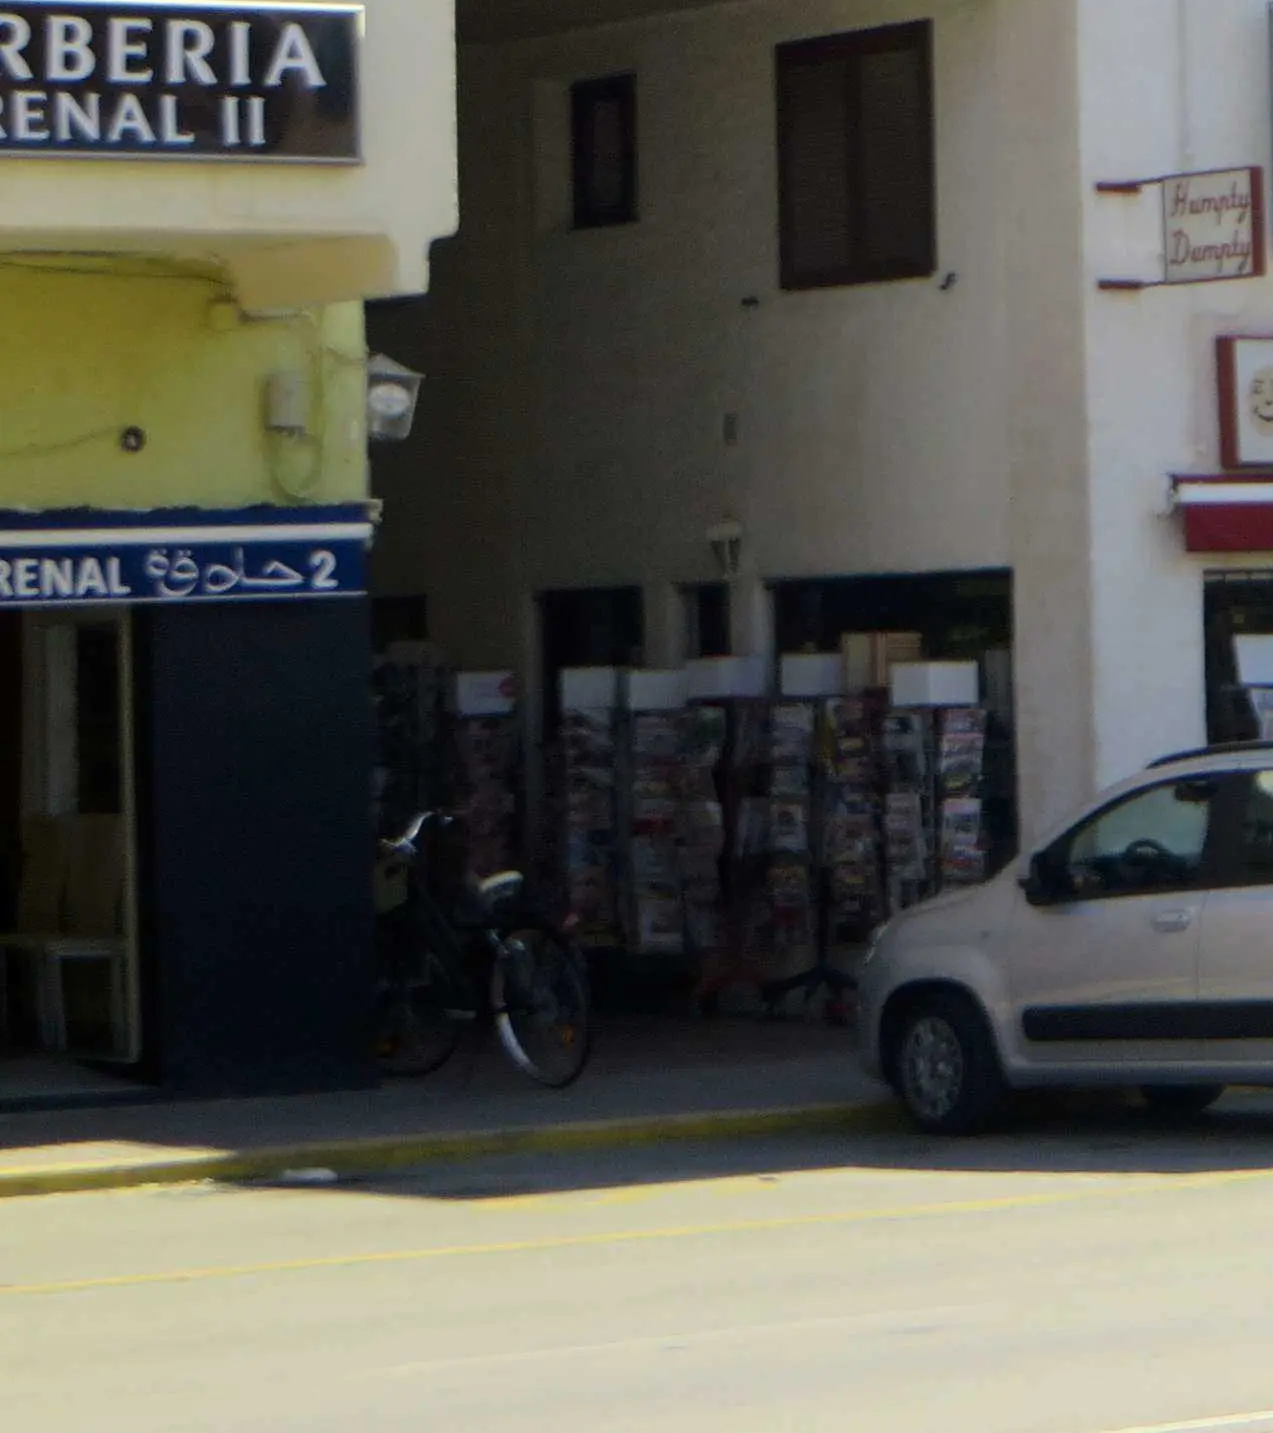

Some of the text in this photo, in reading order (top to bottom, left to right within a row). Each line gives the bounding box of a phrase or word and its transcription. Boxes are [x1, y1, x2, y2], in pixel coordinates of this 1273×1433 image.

[0, 91, 267, 146] ENAL II
[1171, 180, 1251, 225] Humpty
[1169, 228, 1251, 275] Dumpty
